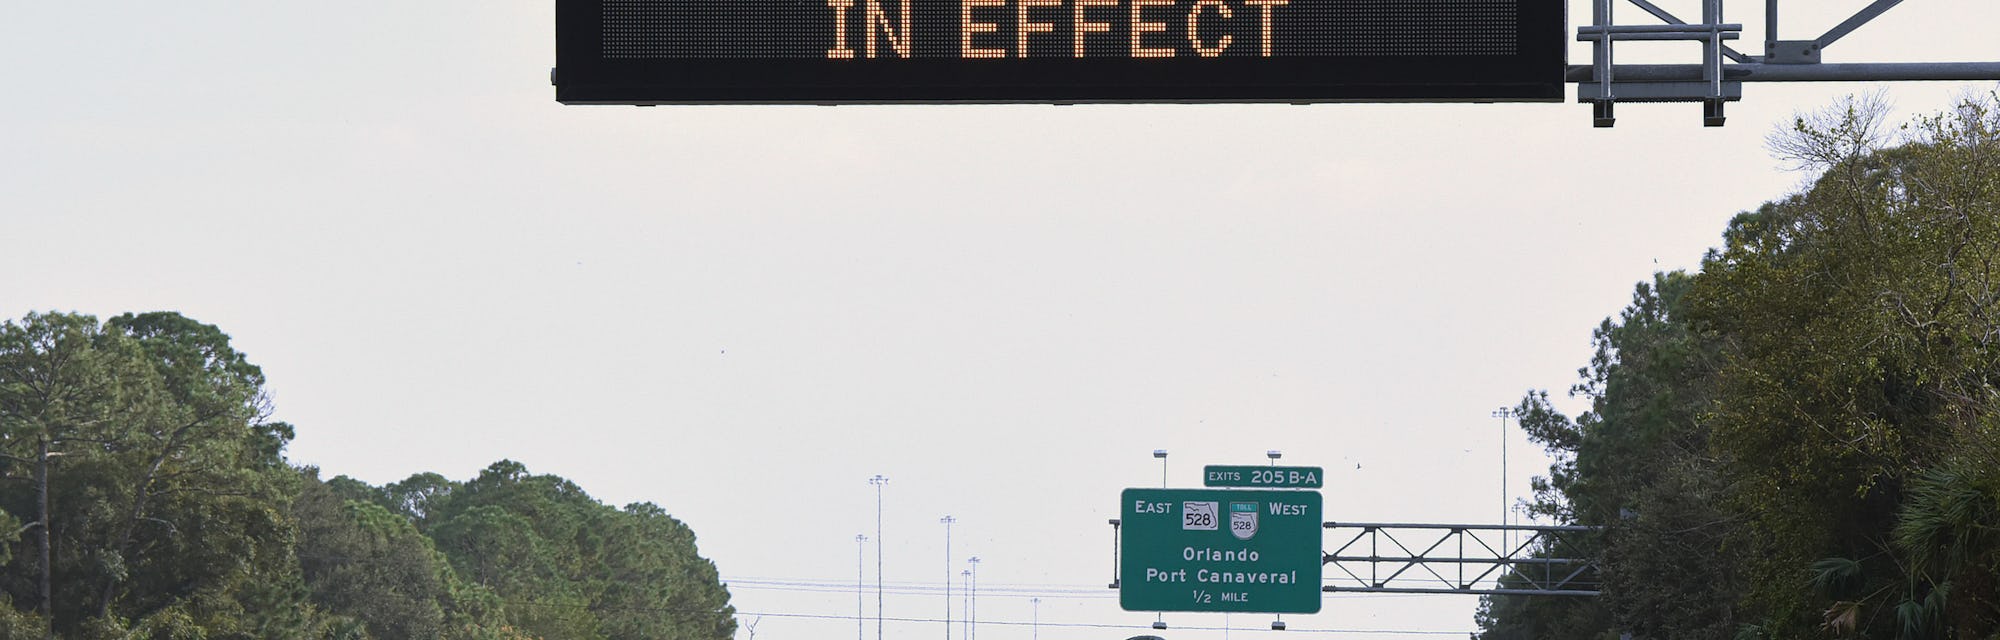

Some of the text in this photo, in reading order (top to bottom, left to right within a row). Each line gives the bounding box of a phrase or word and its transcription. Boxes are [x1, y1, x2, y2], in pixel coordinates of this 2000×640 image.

[827, 0, 1289, 59] IN EFFECT
[1209, 470, 1317, 484] EXITS 205 B-A
[1135, 500, 1172, 514] EAST
[1236, 503, 1252, 511] TOLL
[1269, 502, 1308, 516] WEST
[1185, 513, 1211, 526] 528
[1233, 521, 1252, 531] 528
[1183, 546, 1260, 562] Orlando
[1146, 568, 1297, 584] Port Canaveral
[1193, 590, 1249, 604] 1/2 MILE
